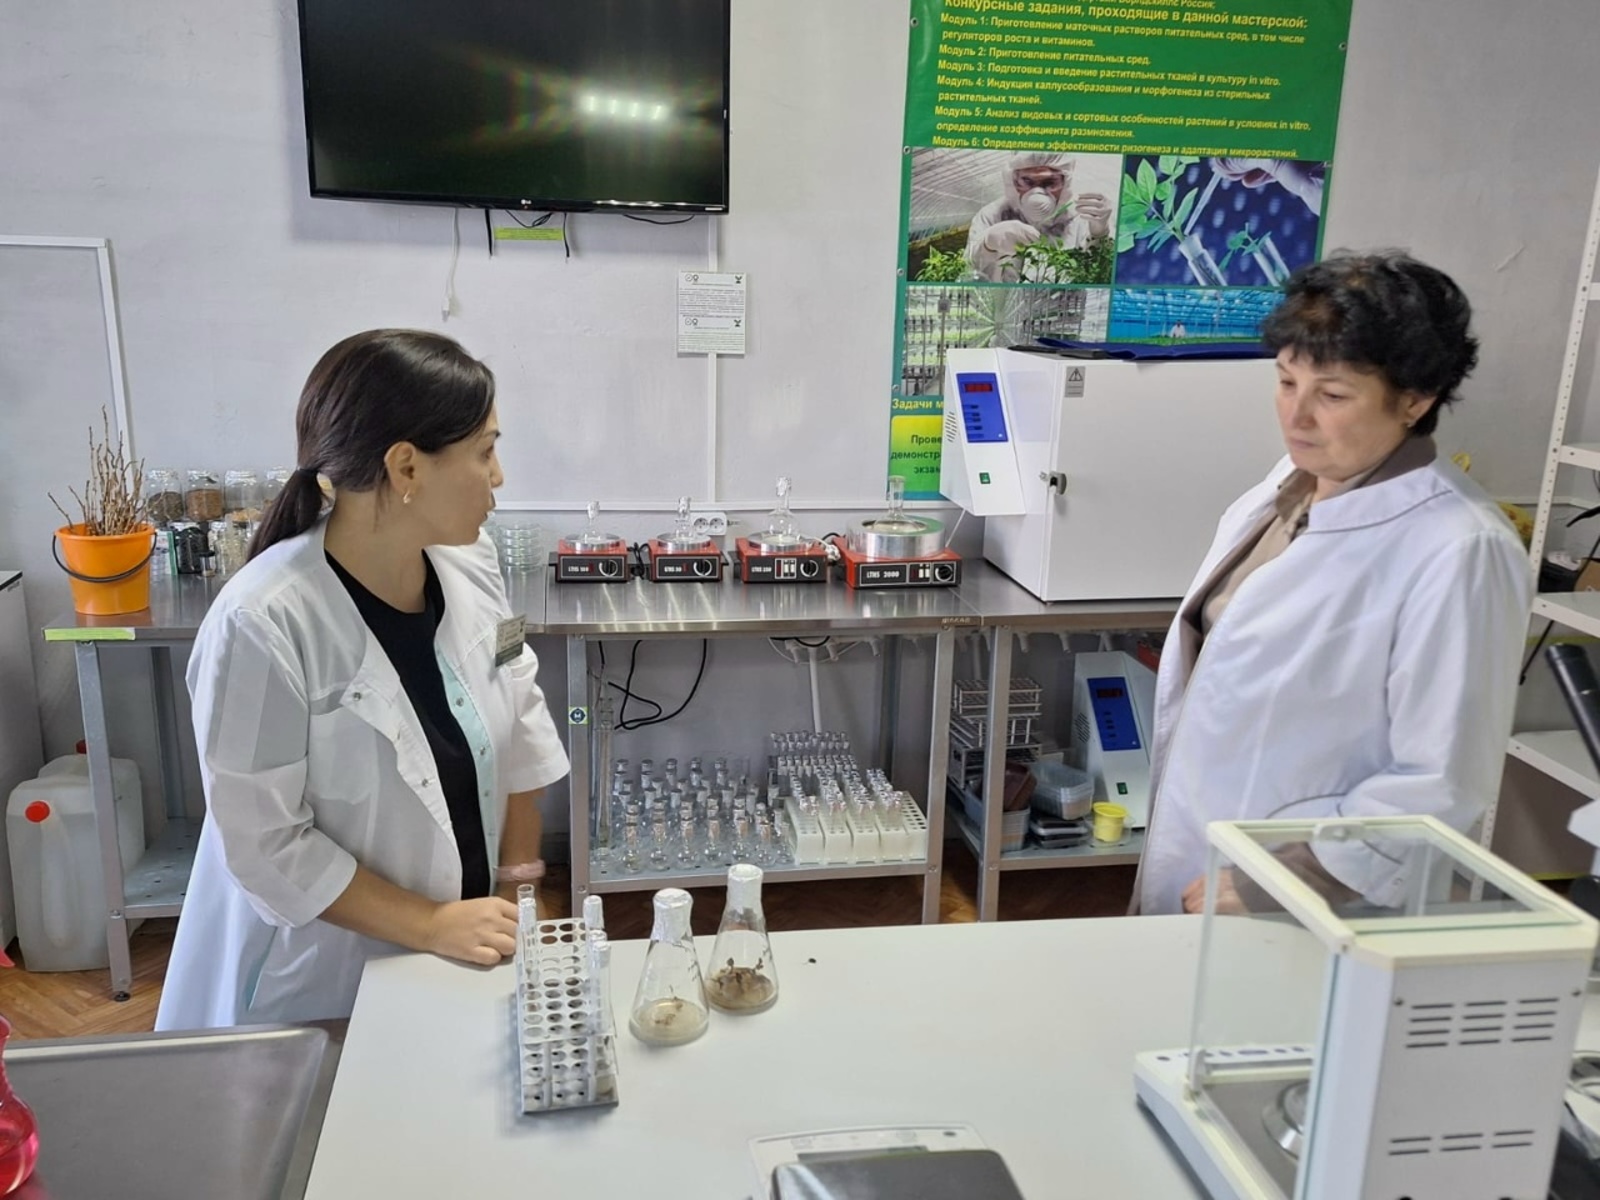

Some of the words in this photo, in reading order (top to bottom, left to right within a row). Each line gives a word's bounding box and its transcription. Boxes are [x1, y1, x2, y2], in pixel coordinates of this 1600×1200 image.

[945, 0, 1025, 12] Конкурсные
[1028, 3, 1085, 15] задания,
[1088, 6, 1169, 20] проходящие
[1182, 12, 1229, 23] данной
[1232, 16, 1308, 28] мастерской:
[940, 13, 978, 26] Модуль
[980, 16, 989, 24] 1:
[990, 17, 1063, 30] Приготовление
[1065, 23, 1112, 32] маточных
[1114, 26, 1163, 36] растворов
[1164, 29, 1224, 39] питательных
[1226, 32, 1250, 41] сред,
[1260, 34, 1277, 42] том
[1278, 35, 1305, 43] числе
[942, 31, 1002, 42] регуляторов
[1004, 35, 1031, 43] роста
[1042, 37, 1096, 46] витаминов.
[939, 44, 976, 56] Модуль
[977, 47, 987, 56] 2:
[989, 47, 1061, 60] Приготовление
[1063, 53, 1125, 63] питательных
[1126, 56, 1152, 65] сред.
[938, 60, 975, 72] Модуль
[976, 63, 986, 71] 3:
[987, 63, 1043, 74] Подготовка
[1053, 68, 1098, 77] введение
[1099, 70, 1166, 80] растительных
[1168, 73, 1197, 81] тканей
[1206, 75, 1247, 86] культуру
[1249, 76, 1258, 84] in
[1259, 77, 1281, 86] vitro.
[936, 75, 974, 87] Модуль
[975, 78, 985, 86] 4:
[1035, 82, 1132, 93] каллусообразования
[1142, 87, 1202, 96] морфогенеза
[1216, 90, 1271, 99] стерильных
[938, 93, 1007, 103] растительных
[1008, 96, 1043, 104] тканей.
[935, 106, 973, 117] Модуль
[974, 107, 983, 116] 5:
[985, 108, 1020, 118] Анализ
[1021, 111, 1063, 120] видовых
[1073, 114, 1118, 122] сортовых
[1120, 115, 1184, 124] особенностей
[1185, 118, 1227, 126] растений
[1235, 120, 1277, 129] условиях
[1279, 121, 1288, 129] in
[1289, 121, 1311, 130] vitro,
[936, 123, 999, 132] определение
[1000, 125, 1069, 135] коэффициента
[1071, 129, 1136, 137] размножения.
[932, 136, 970, 147] Модуль
[982, 138, 1045, 150] Определение
[1046, 142, 1120, 153] эффективности
[1121, 145, 1171, 155] ризогенеза
[1180, 147, 1228, 157] адаптация
[1229, 149, 1299, 159] микрорастений.
[892, 398, 933, 410] Задачи
[891, 451, 941, 460] демонстр
